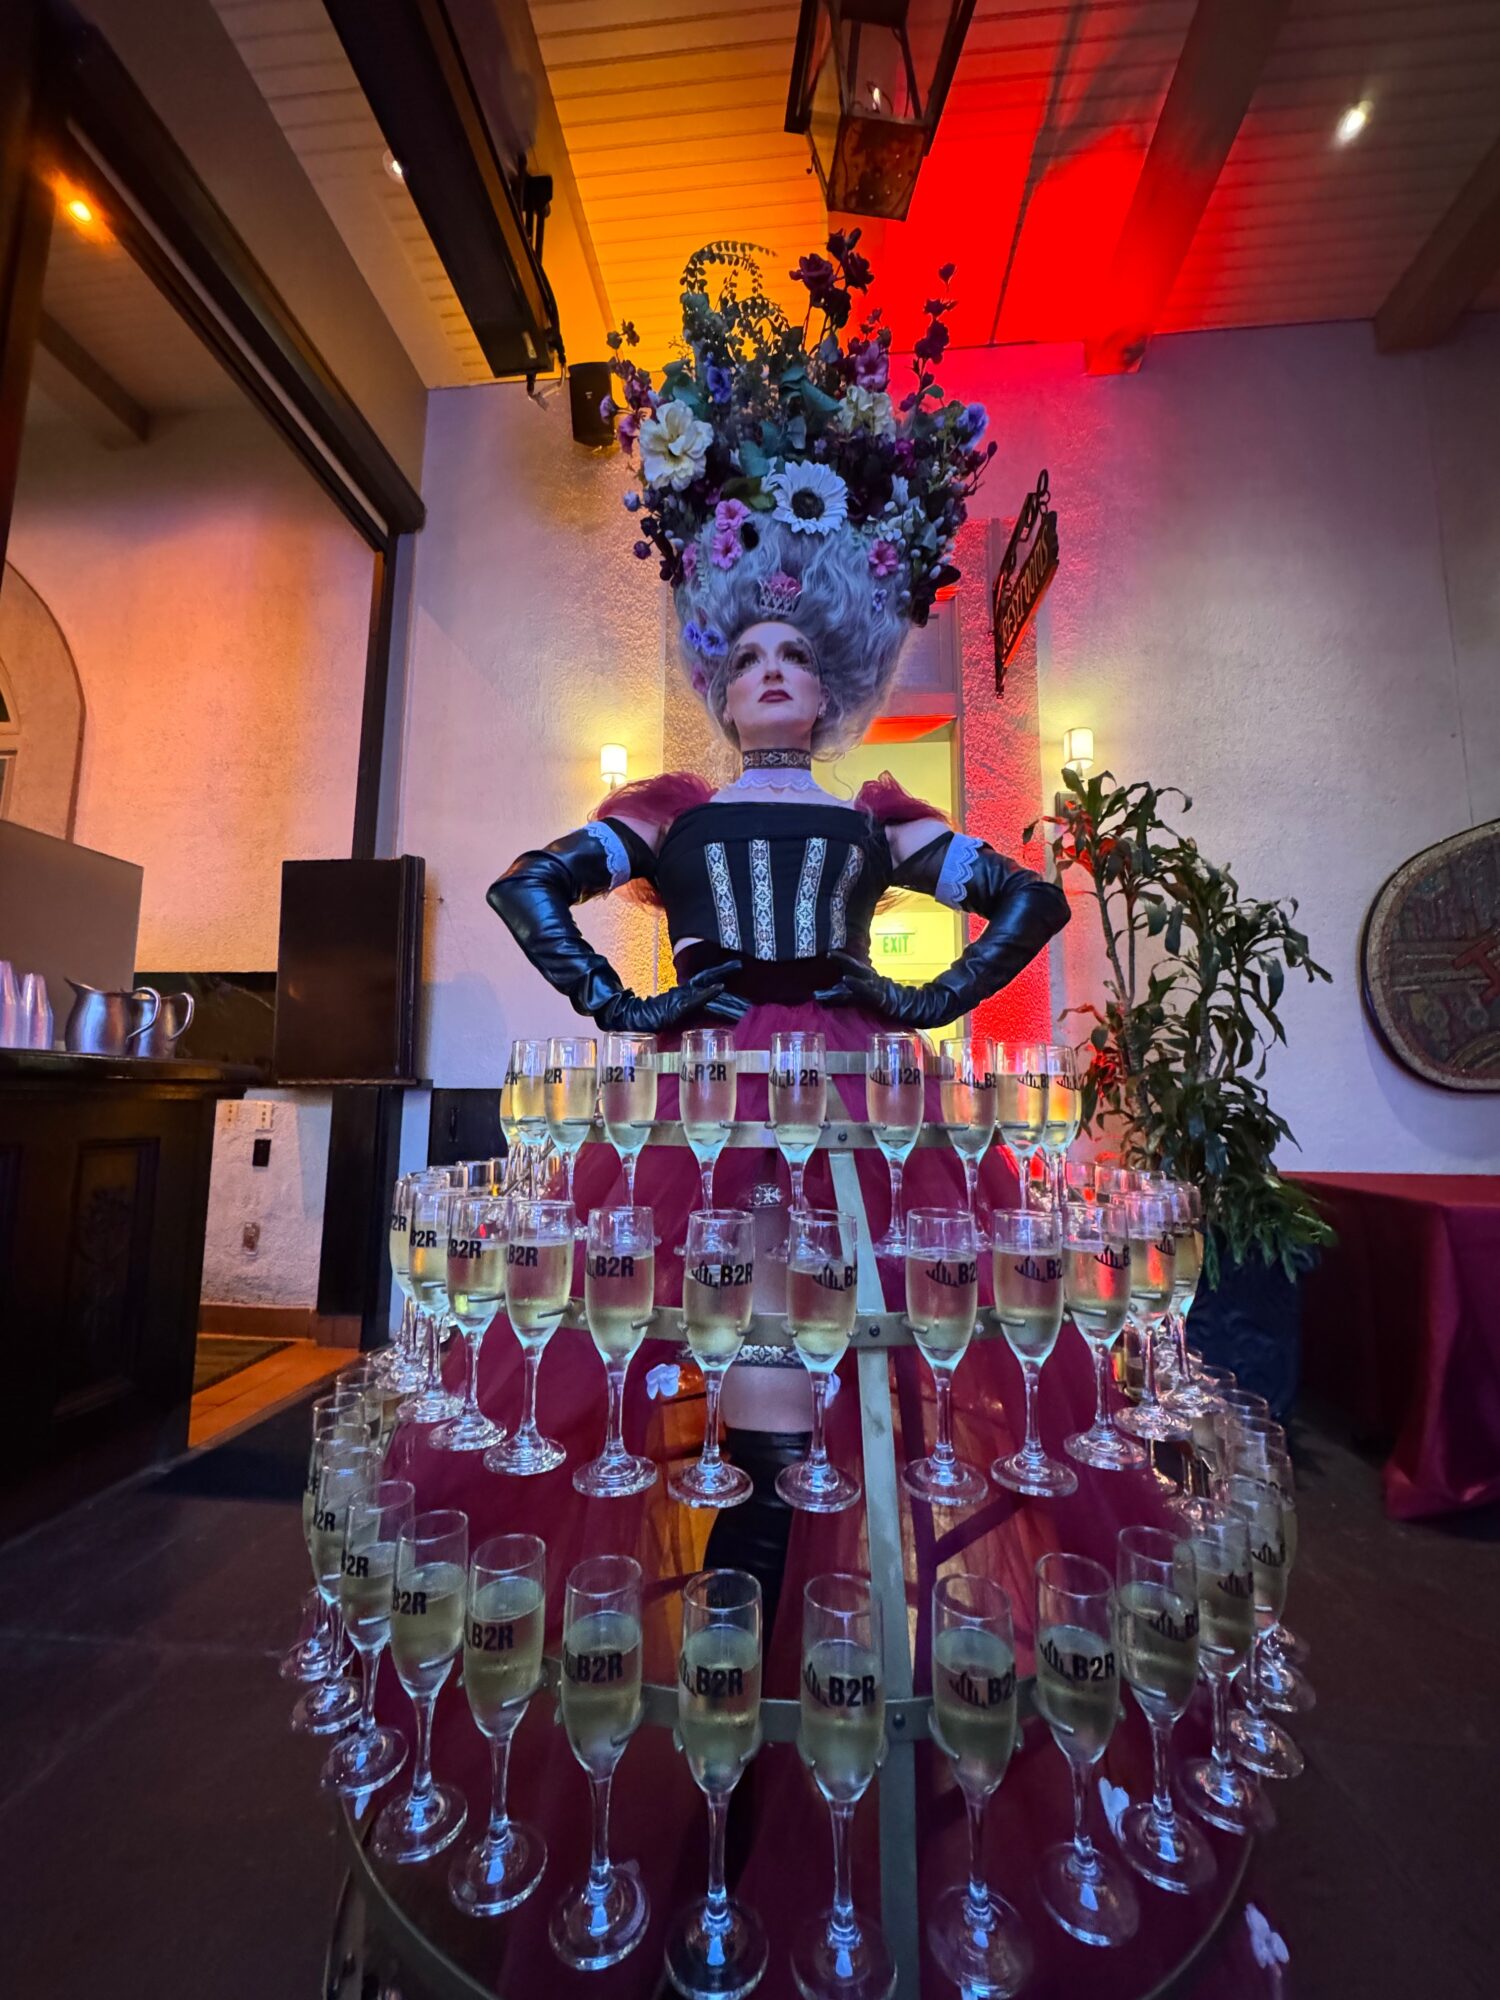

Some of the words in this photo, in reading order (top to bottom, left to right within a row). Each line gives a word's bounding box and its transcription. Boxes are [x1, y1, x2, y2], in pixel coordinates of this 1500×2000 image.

[883, 935, 908, 953] EXIT
[605, 1066, 635, 1083] B2R
[695, 1064, 727, 1082] B2R
[786, 1069, 818, 1087] B2R
[391, 1215, 407, 1232] 2R
[450, 1239, 482, 1259] B2R
[507, 1244, 538, 1267] B2R
[595, 1256, 634, 1279] B2R
[720, 1263, 753, 1287] B2R
[958, 1261, 977, 1285] B2
[1046, 1259, 1063, 1280] B2
[392, 1591, 427, 1615] B2R
[472, 1623, 513, 1651] B2R
[576, 1653, 623, 1684] B2R
[1072, 1652, 1115, 1682] B2R
[696, 1666, 743, 1698] B2R
[828, 1675, 875, 1707] B2R
